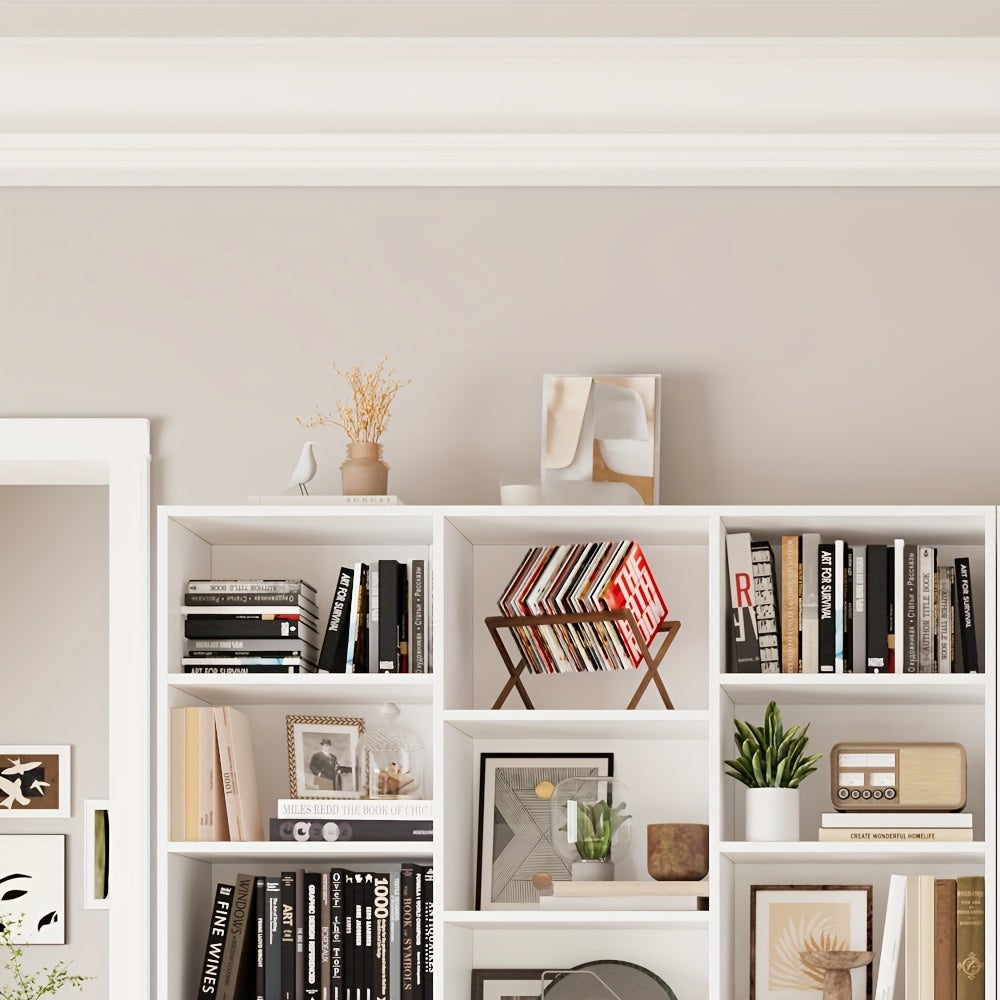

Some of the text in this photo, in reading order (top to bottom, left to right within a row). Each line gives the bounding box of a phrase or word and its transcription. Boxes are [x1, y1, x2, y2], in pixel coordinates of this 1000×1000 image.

[821, 551, 831, 565] ART
[340, 573, 351, 587] ART
[821, 567, 832, 587] FOR
[961, 579, 969, 594] FOR
[337, 587, 348, 601] FOR
[282, 804, 428, 816] MILES REDD THE BOOK OF CHIC
[231, 879, 250, 936] WINDOWS
[374, 878, 389, 919] 1000
[282, 903, 294, 926] ART
[202, 900, 230, 994] FINE WINES
[321, 926, 329, 963] BORDEAUX
[403, 898, 412, 990] BOOK SYMBOLS
